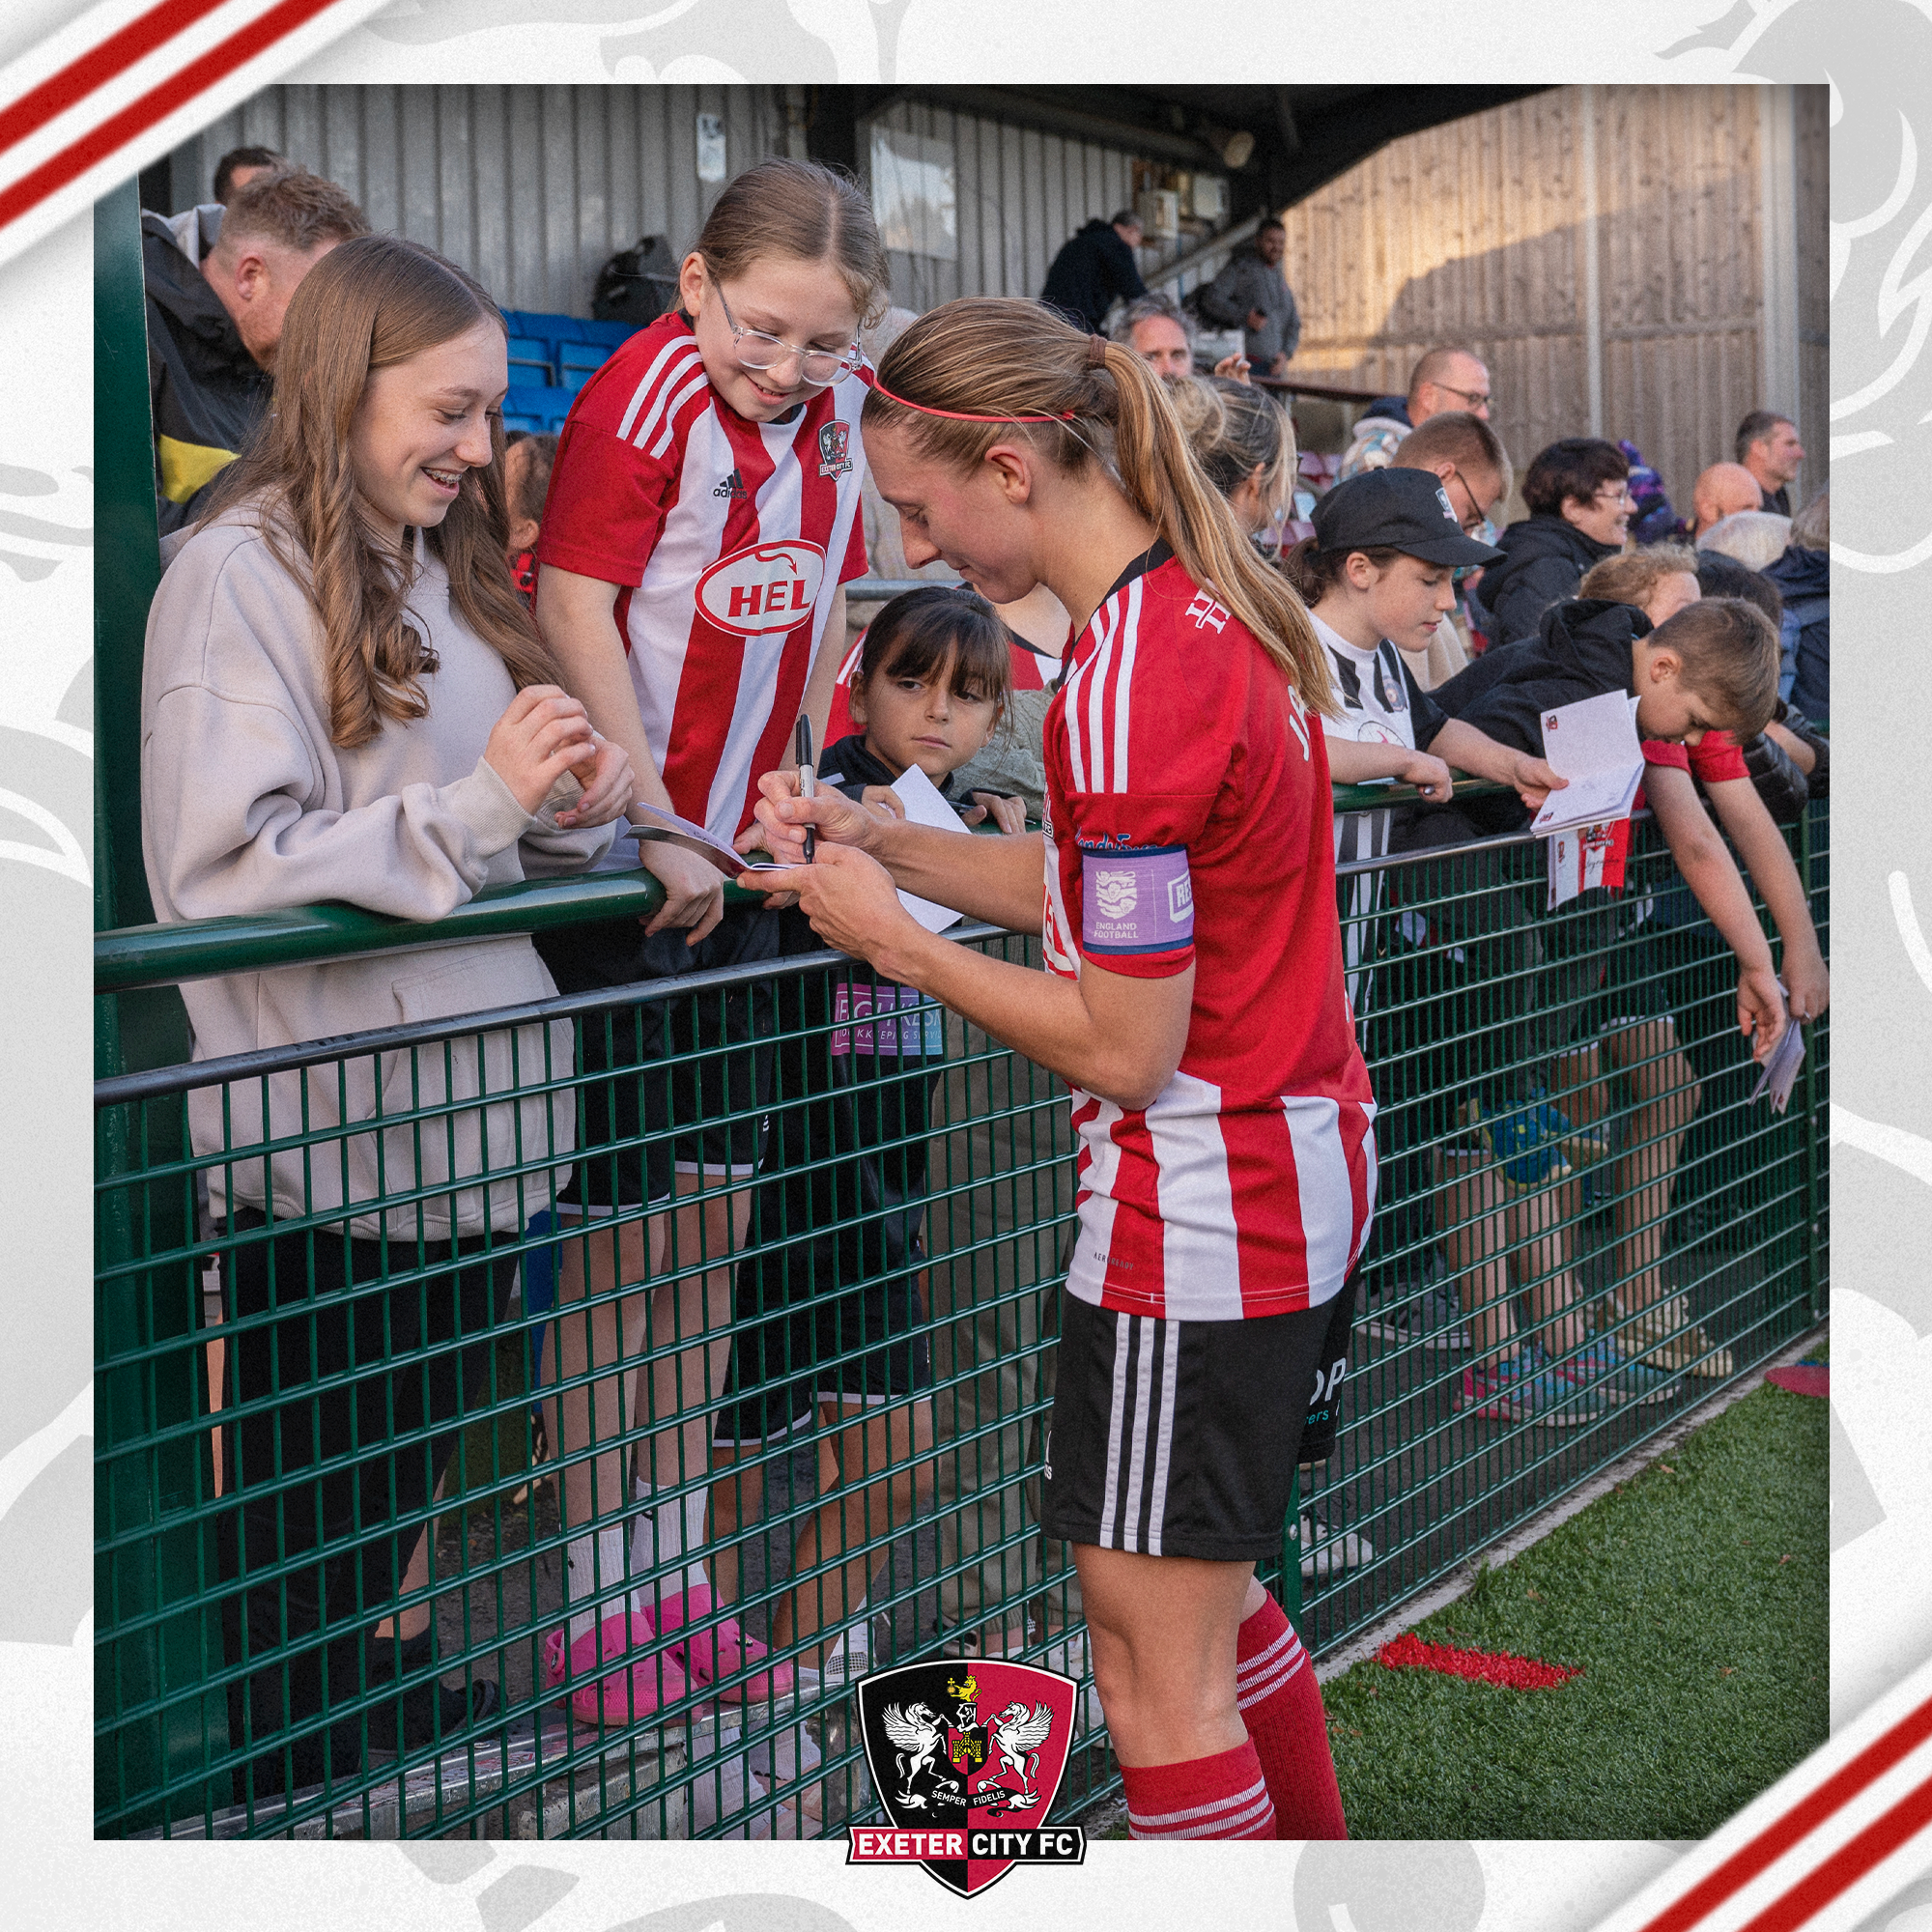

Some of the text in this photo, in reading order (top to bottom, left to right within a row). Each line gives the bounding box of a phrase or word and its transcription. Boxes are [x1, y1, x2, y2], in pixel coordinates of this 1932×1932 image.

[713, 486, 748, 498] adidas
[727, 580, 811, 617] HEL
[1095, 922, 1137, 930] ENGLAND
[1094, 930, 1139, 939] FOOTBALL
[1094, 1251, 1134, 1270] AEROREADY
